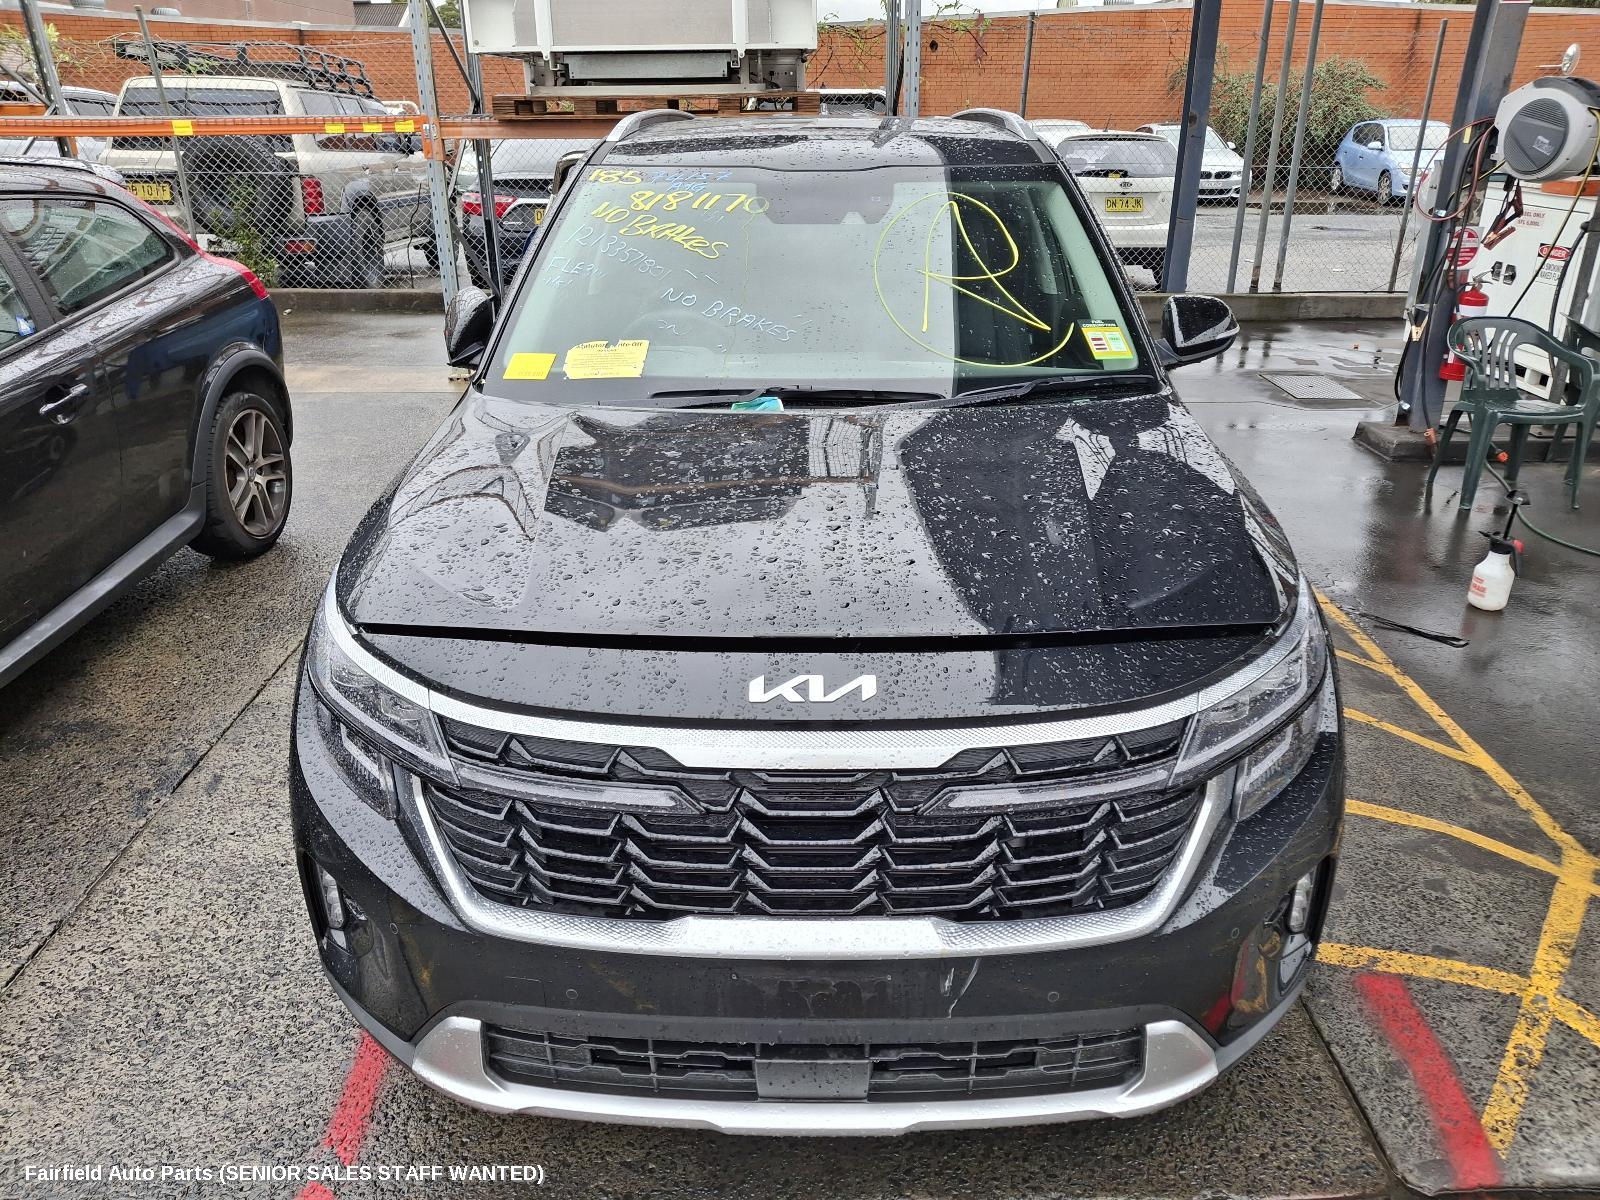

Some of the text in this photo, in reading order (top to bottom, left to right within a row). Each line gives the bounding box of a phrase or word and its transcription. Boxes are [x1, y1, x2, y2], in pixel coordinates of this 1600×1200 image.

[588, 169, 641, 185] 185
[591, 201, 630, 223] NO
[1542, 247, 1566, 258] DNGER
[660, 287, 697, 306] NO
[702, 300, 797, 341] BRAKES
[748, 674, 877, 703] KIA
